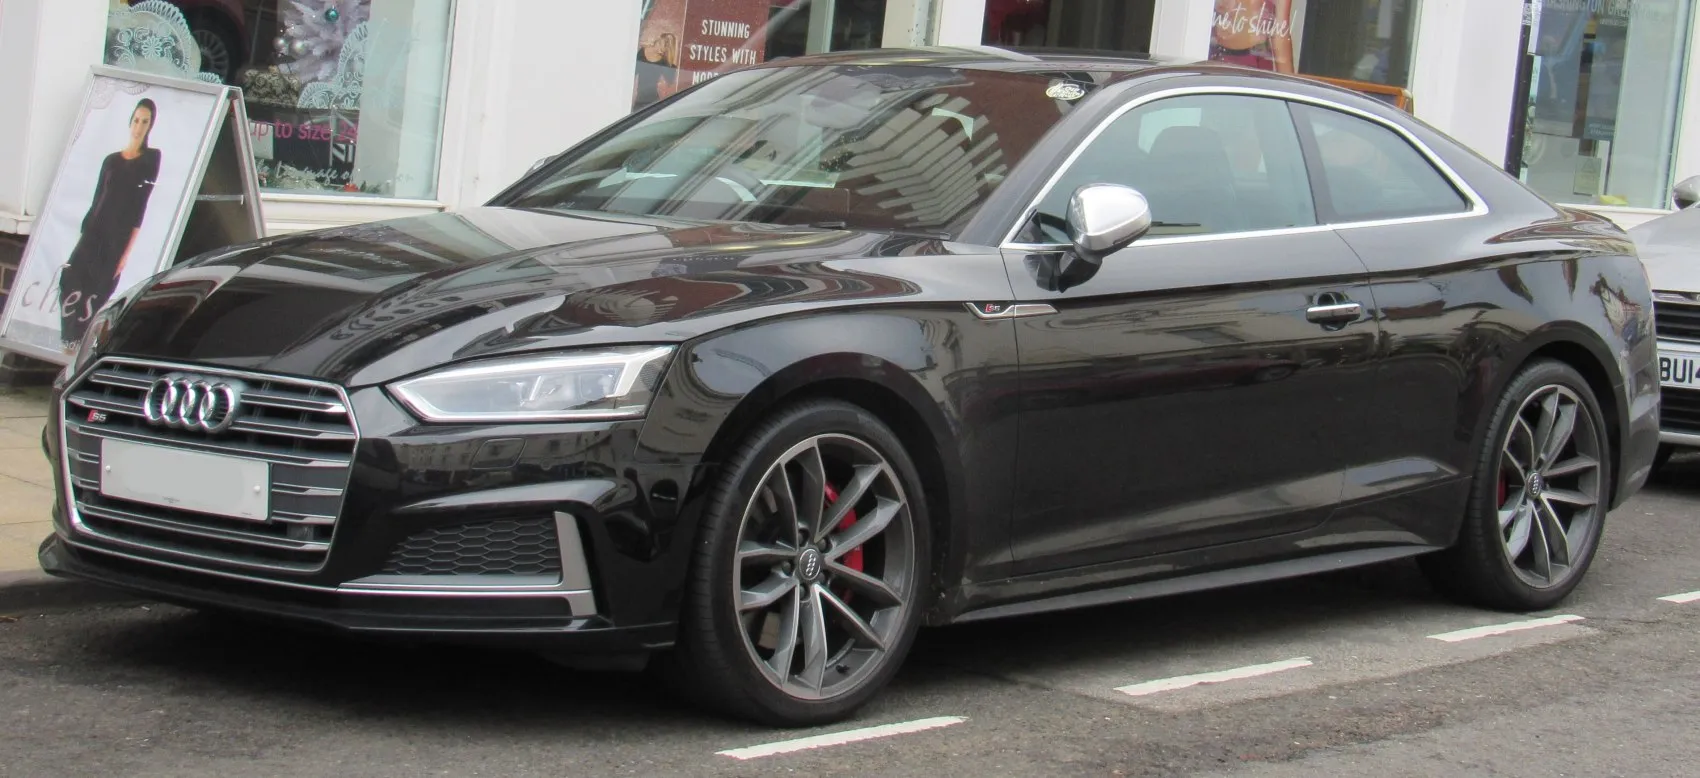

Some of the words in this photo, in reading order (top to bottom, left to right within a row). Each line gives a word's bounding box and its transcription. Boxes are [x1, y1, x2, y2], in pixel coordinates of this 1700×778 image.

[701, 19, 750, 39] STUNNING
[1230, 2, 1248, 34] to
[1247, 1, 1298, 41] shine!
[689, 44, 728, 63] STYLES
[732, 48, 757, 65] WITH
[274, 119, 293, 139] to
[297, 121, 331, 141] size
